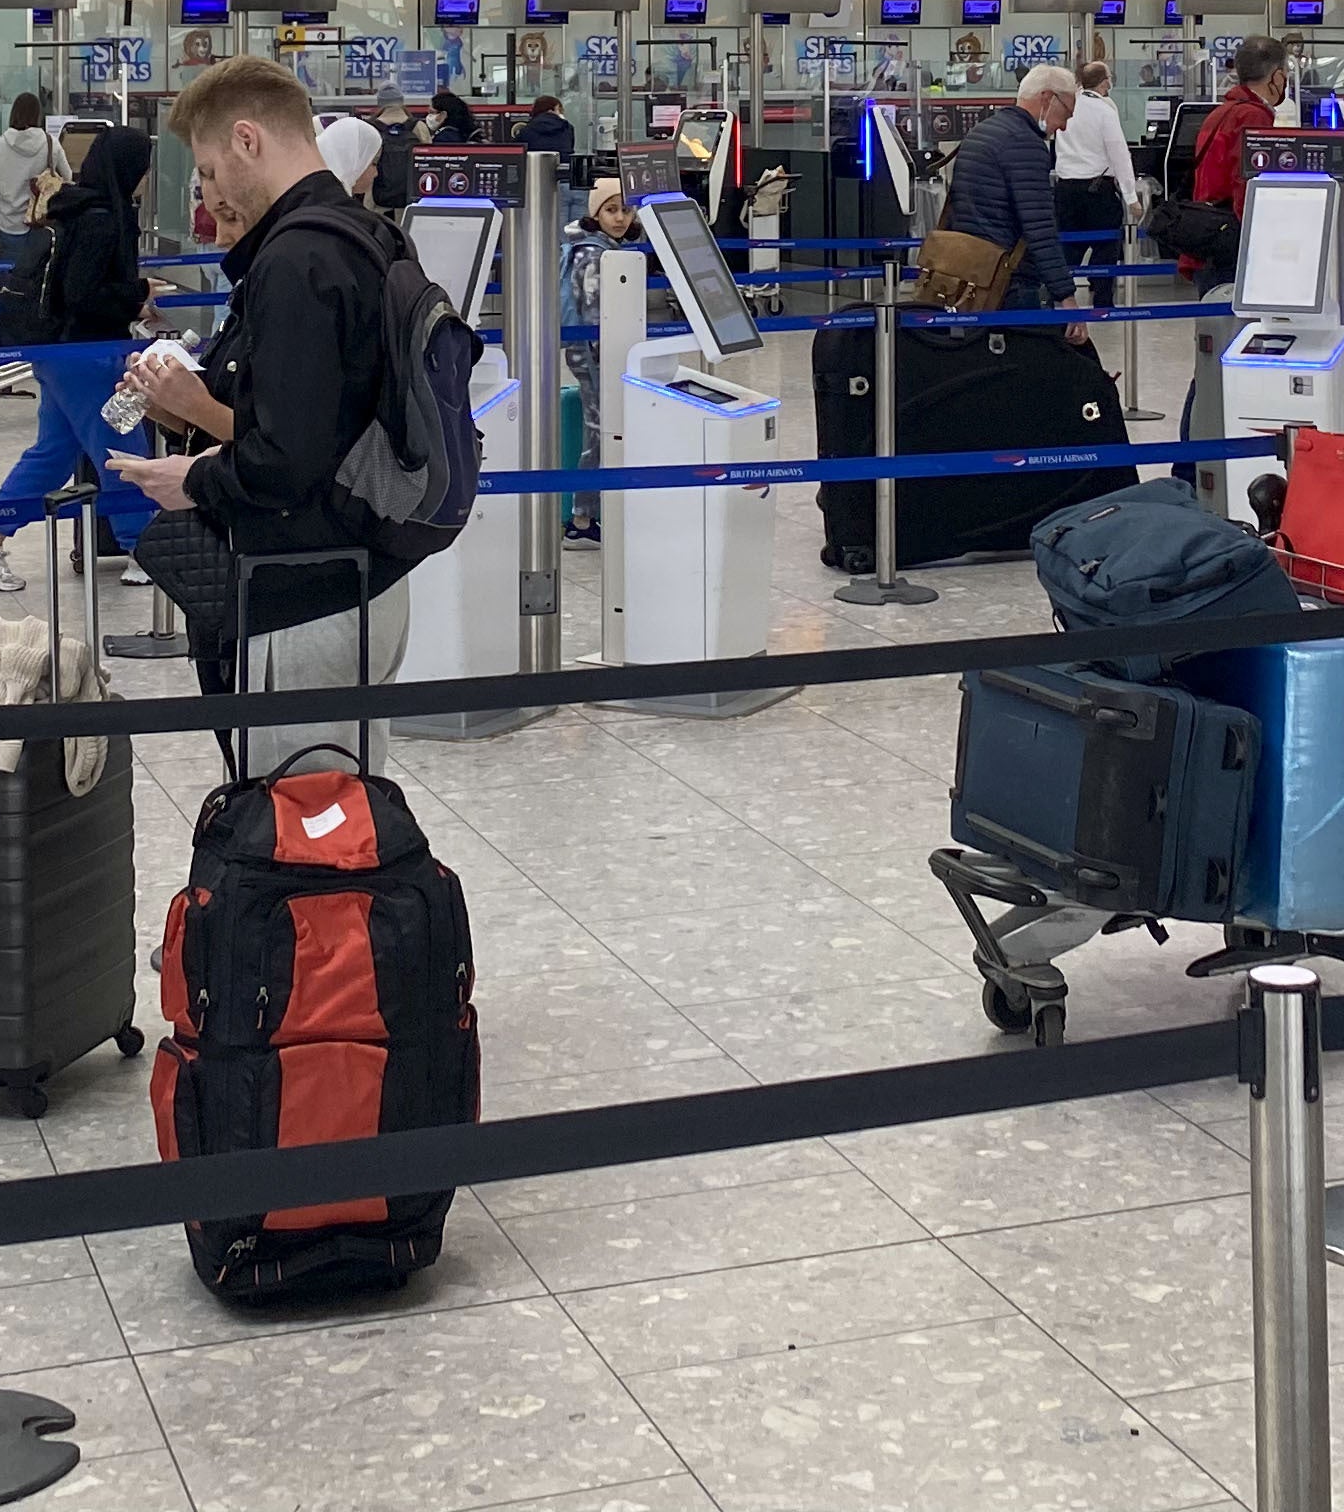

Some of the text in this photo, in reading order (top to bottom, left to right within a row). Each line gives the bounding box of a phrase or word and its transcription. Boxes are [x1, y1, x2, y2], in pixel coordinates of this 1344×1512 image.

[351, 39, 396, 61] SKY
[587, 38, 618, 57] SK
[1014, 36, 1052, 56] SKY
[84, 64, 150, 80] FLYRS
[1028, 453, 1098, 465] BRITISH AIRWAYS
[730, 467, 803, 479] BRITISH AIRWAYS
